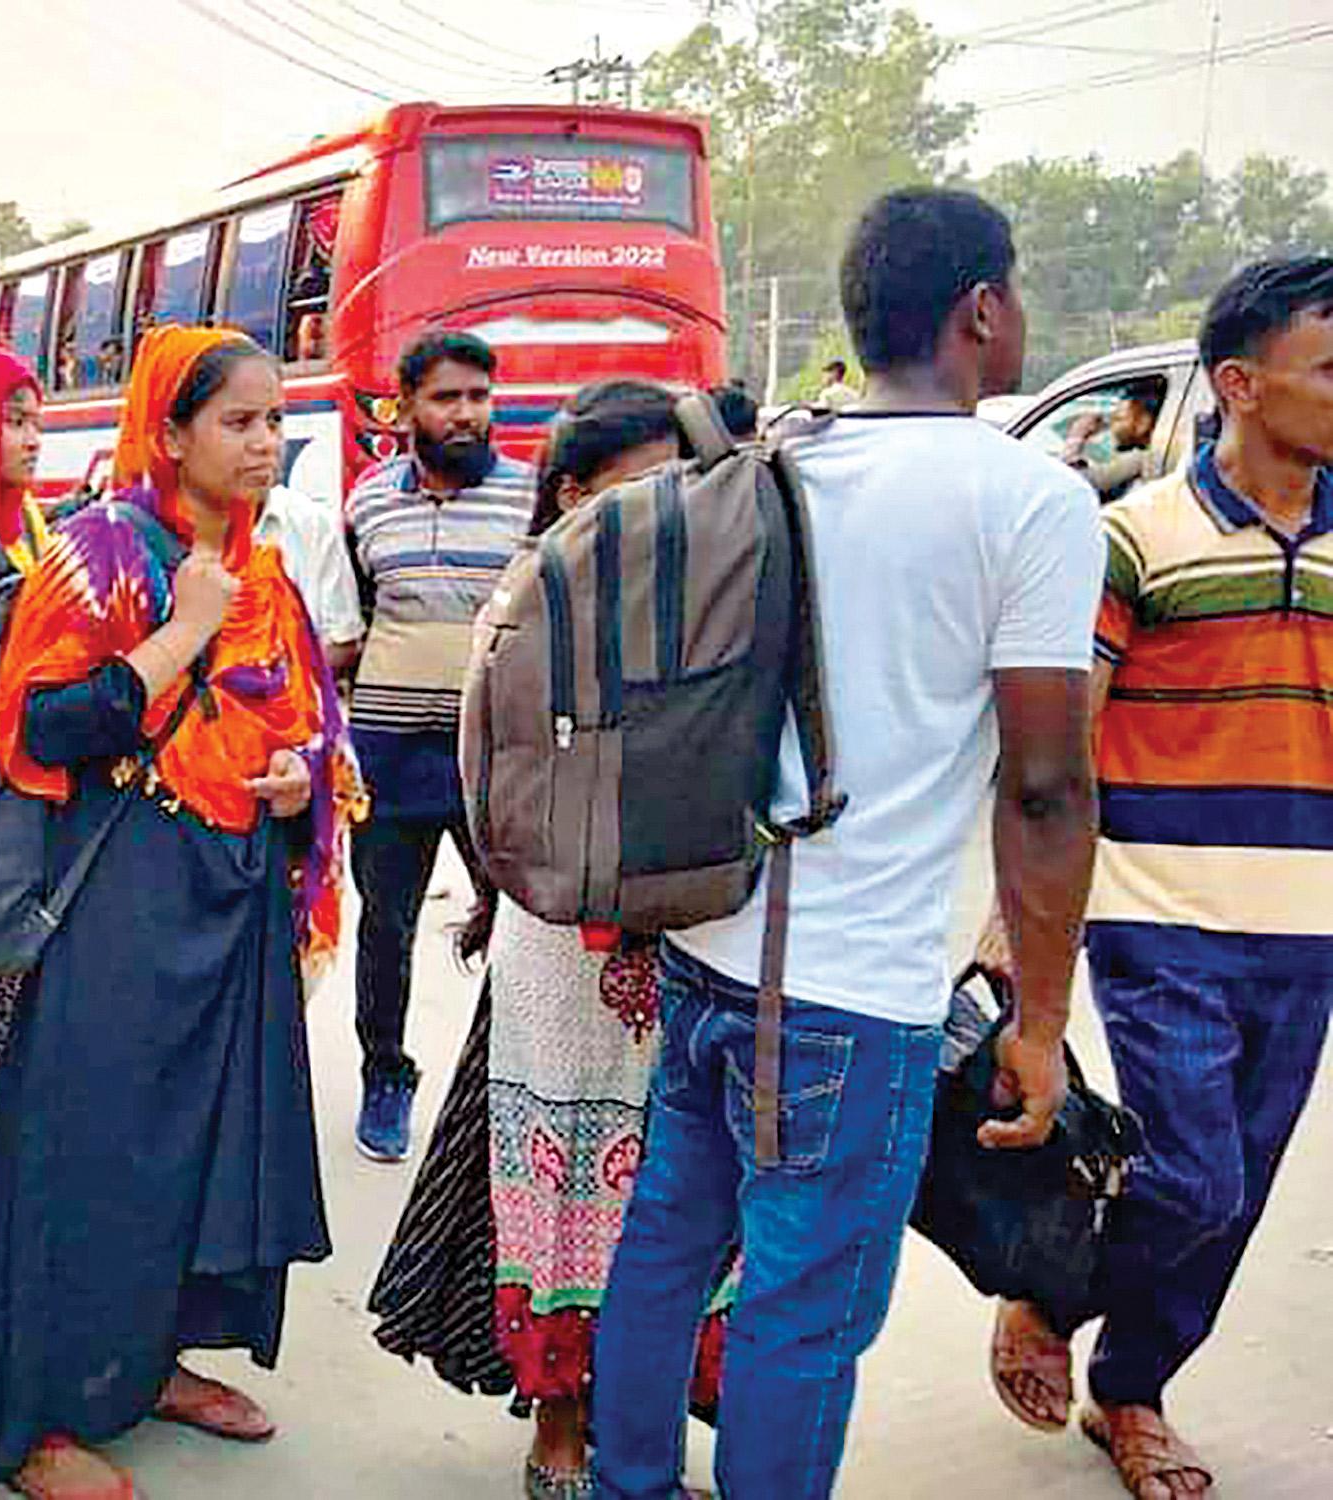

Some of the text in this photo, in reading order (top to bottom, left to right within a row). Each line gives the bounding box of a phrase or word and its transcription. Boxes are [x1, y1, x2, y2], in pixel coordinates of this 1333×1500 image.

[467, 244, 666, 267] New Version 2022
